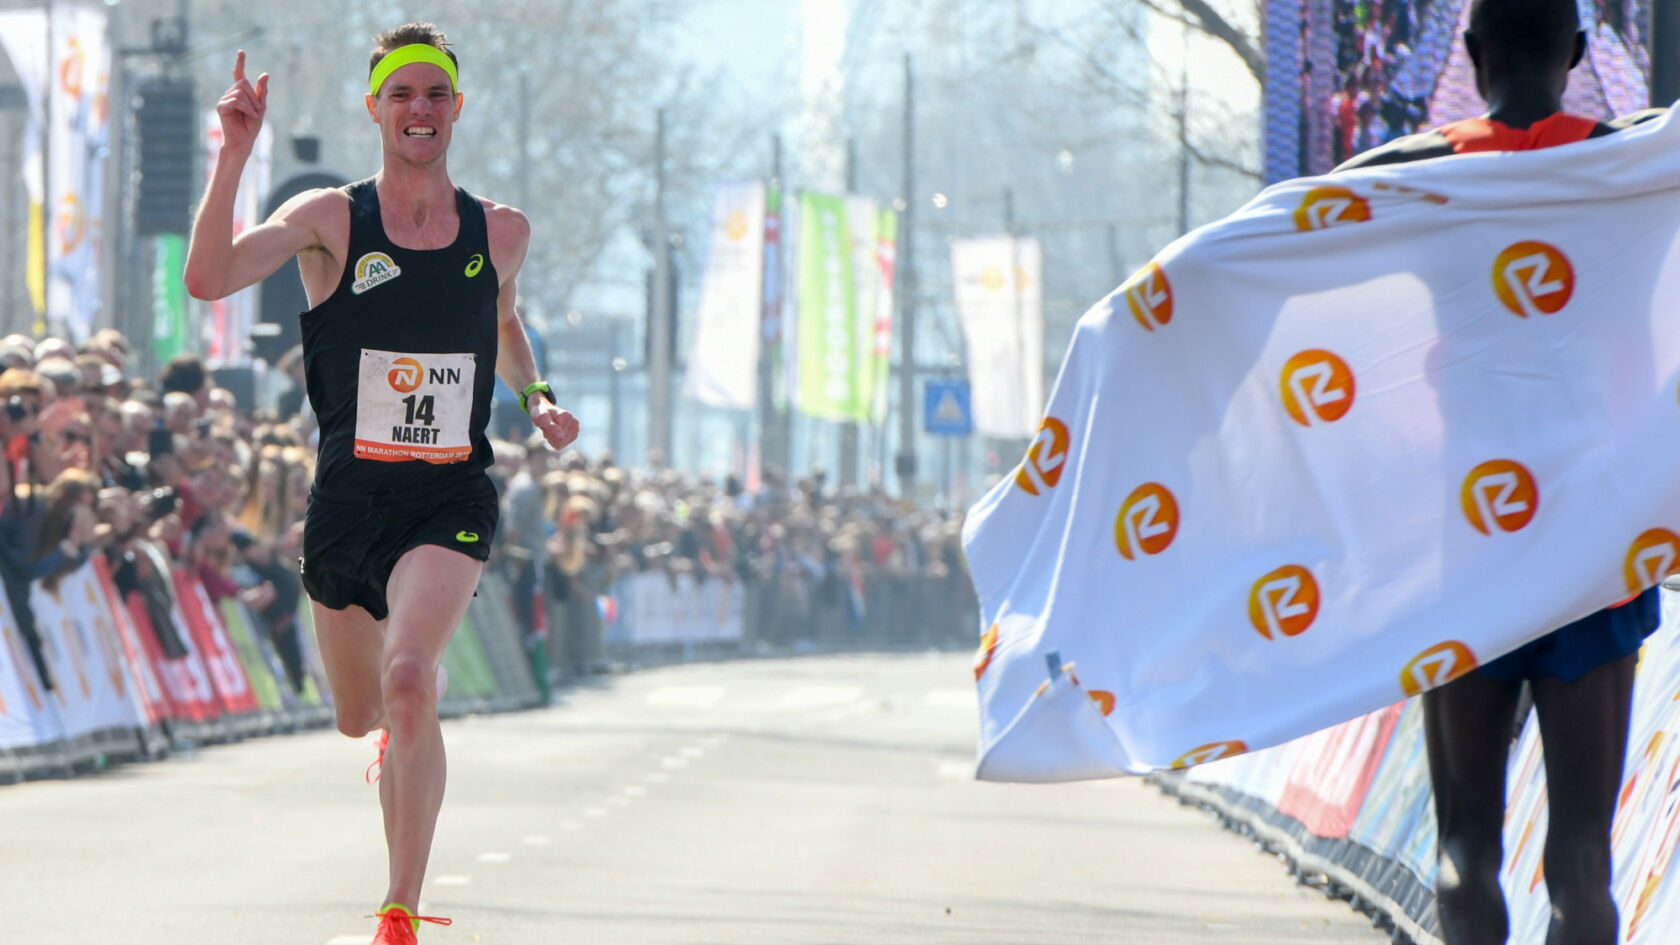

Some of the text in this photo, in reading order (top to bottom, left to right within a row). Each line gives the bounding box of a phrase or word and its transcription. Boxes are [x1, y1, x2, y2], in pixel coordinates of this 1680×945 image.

[368, 261, 387, 278] AA
[366, 270, 393, 287] DRINK
[429, 368, 461, 385] NN
[402, 395, 435, 426] 14
[392, 426, 440, 444] NAERT
[356, 444, 367, 453] NN
[367, 446, 409, 457] MARATHON
[410, 450, 454, 460] ROTTERDAM
